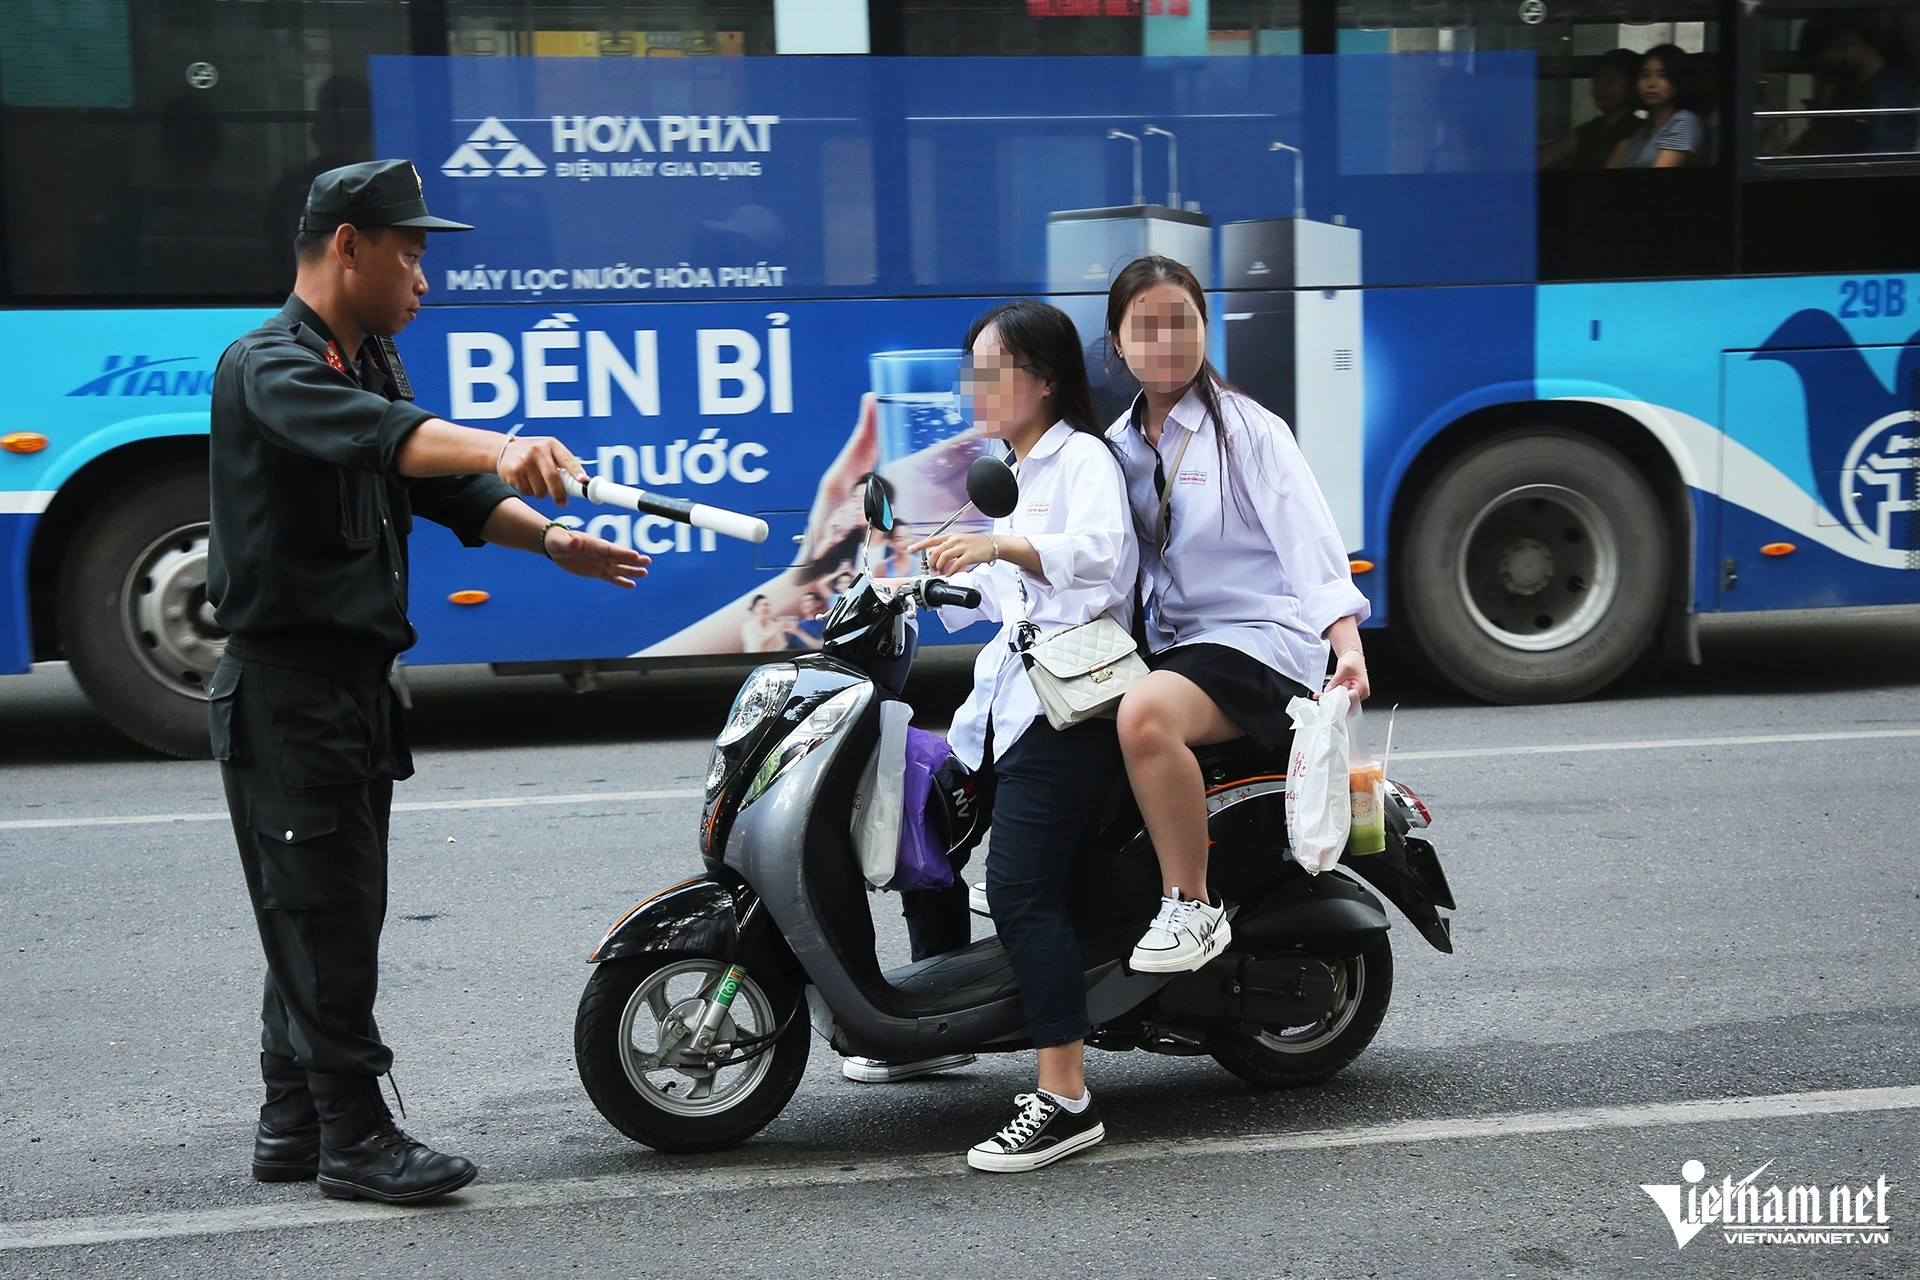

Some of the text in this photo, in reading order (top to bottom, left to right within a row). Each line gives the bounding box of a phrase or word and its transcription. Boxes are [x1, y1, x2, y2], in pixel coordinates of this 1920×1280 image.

[555, 158, 762, 182] ĐIỆN MÁY GIA DỤNG
[446, 261, 787, 296] MÁY LỌC NƯỚC HÒA PHÁT
[447, 312, 793, 420] BỀN BỈ
[597, 428, 770, 486] nước
